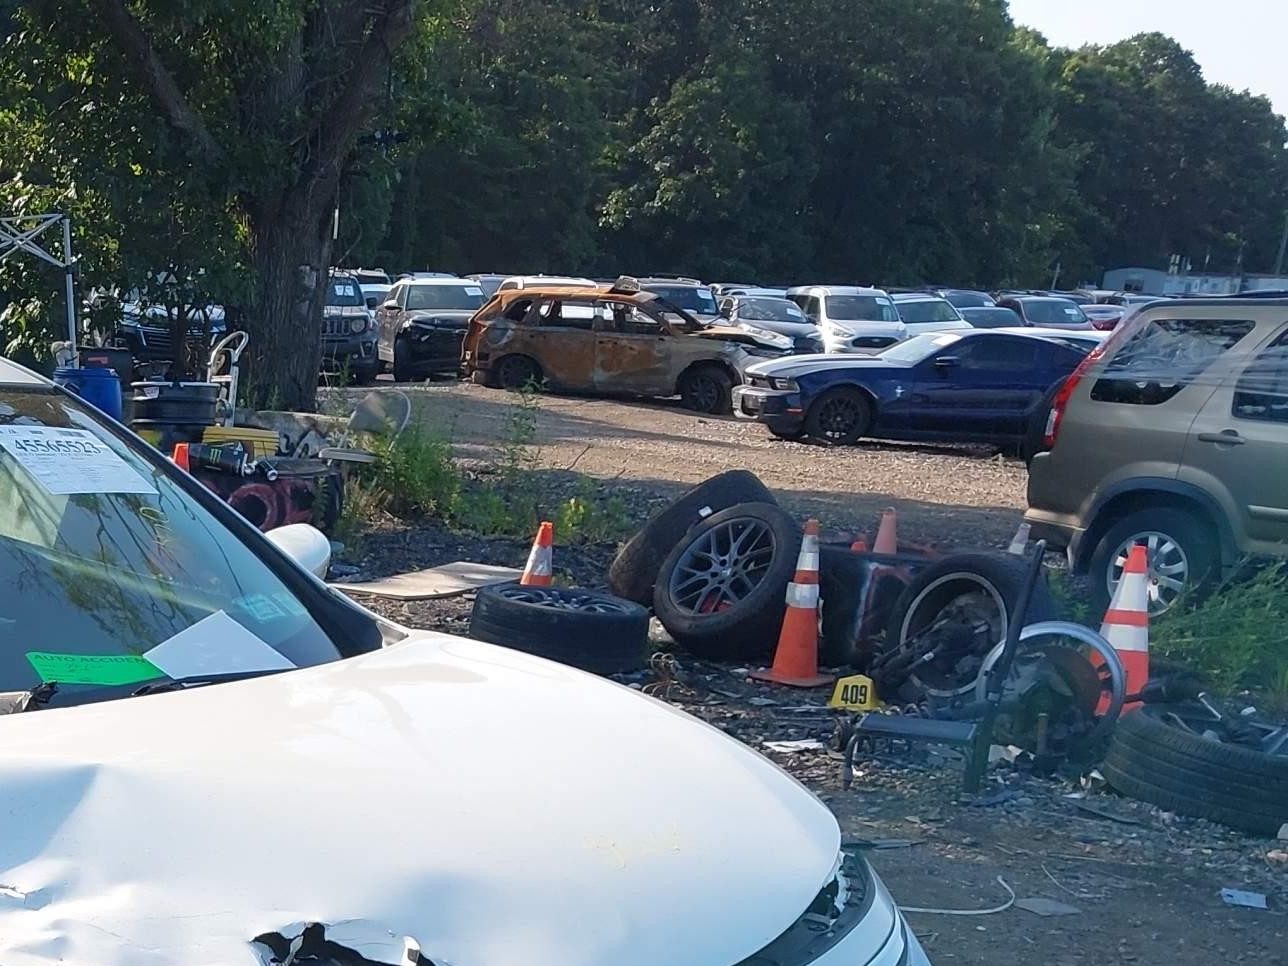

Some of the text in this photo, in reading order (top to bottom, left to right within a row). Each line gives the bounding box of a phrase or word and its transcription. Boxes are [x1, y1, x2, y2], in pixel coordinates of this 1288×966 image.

[14, 438, 102, 455] 45565523
[34, 654, 149, 665] AUTO ACCIDEN
[841, 684, 868, 705] 409
